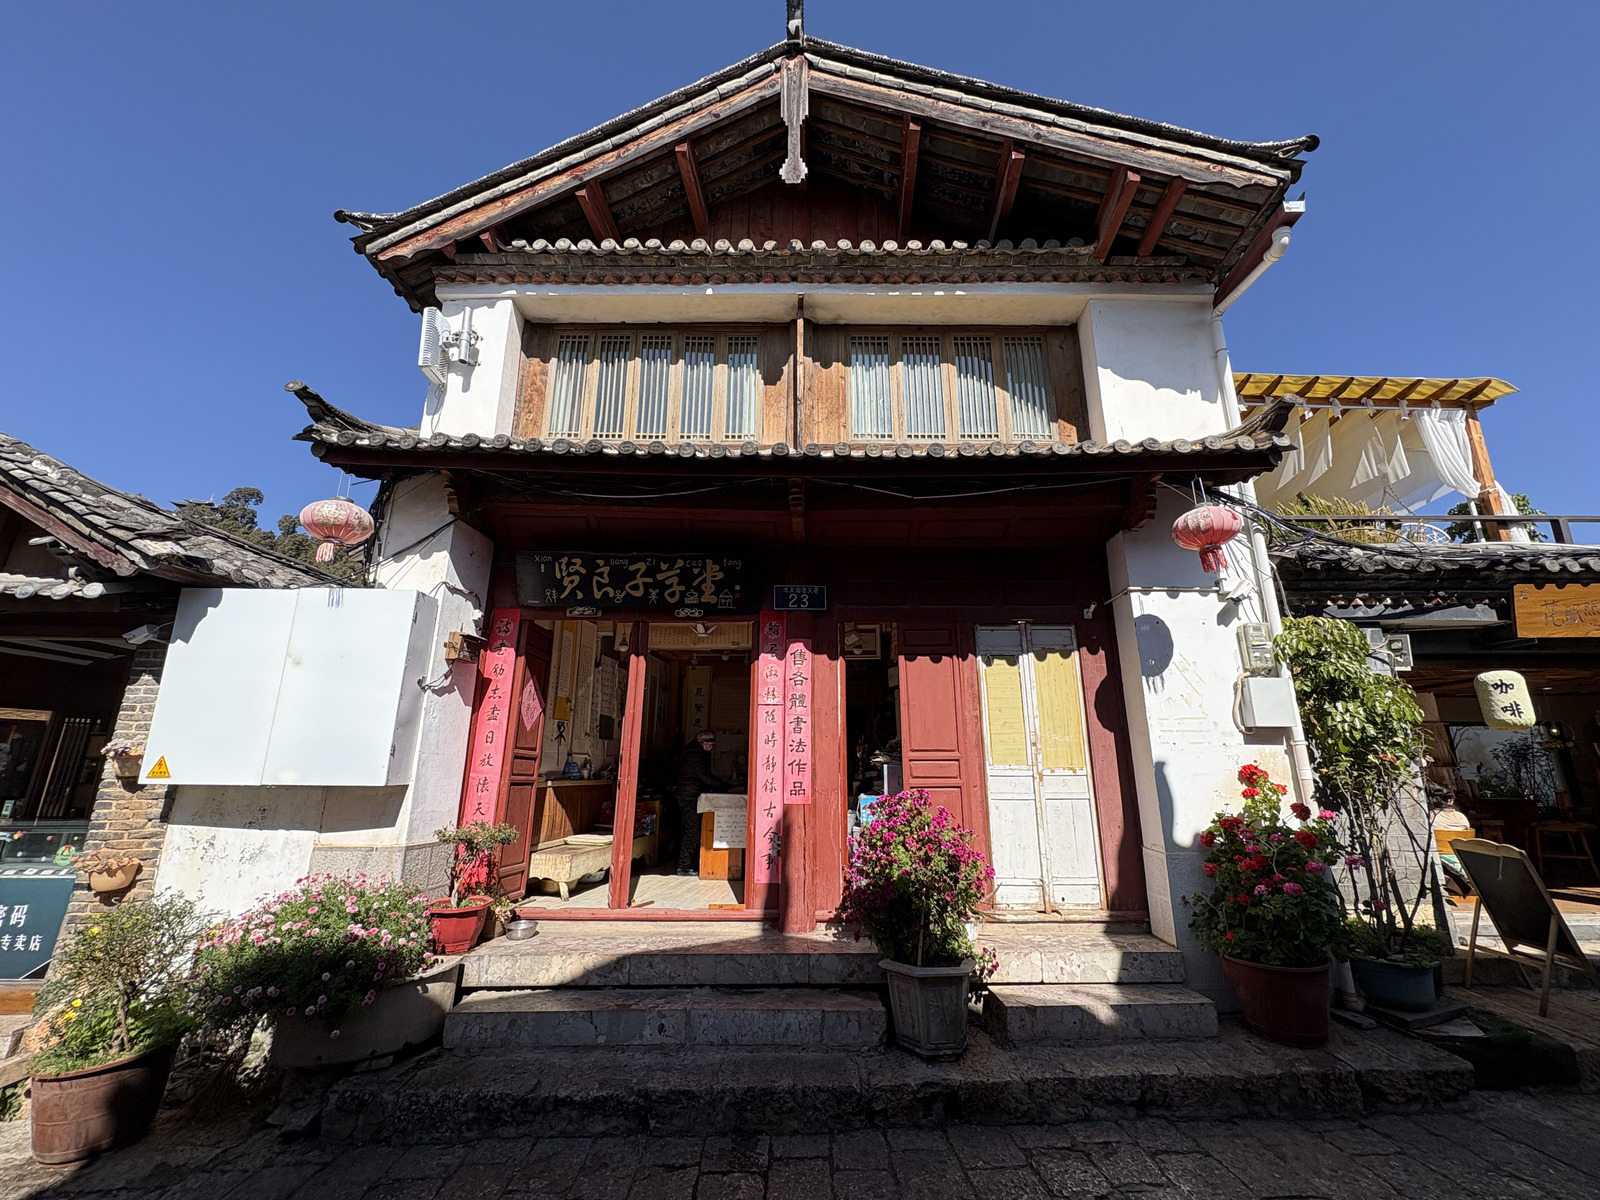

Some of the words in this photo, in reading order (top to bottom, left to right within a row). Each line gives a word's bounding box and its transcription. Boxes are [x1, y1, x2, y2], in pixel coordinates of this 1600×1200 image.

[788, 593, 809, 608] 23
[1491, 679, 1524, 719] 咖啡
[0, 933, 43, 952] 专卖店
